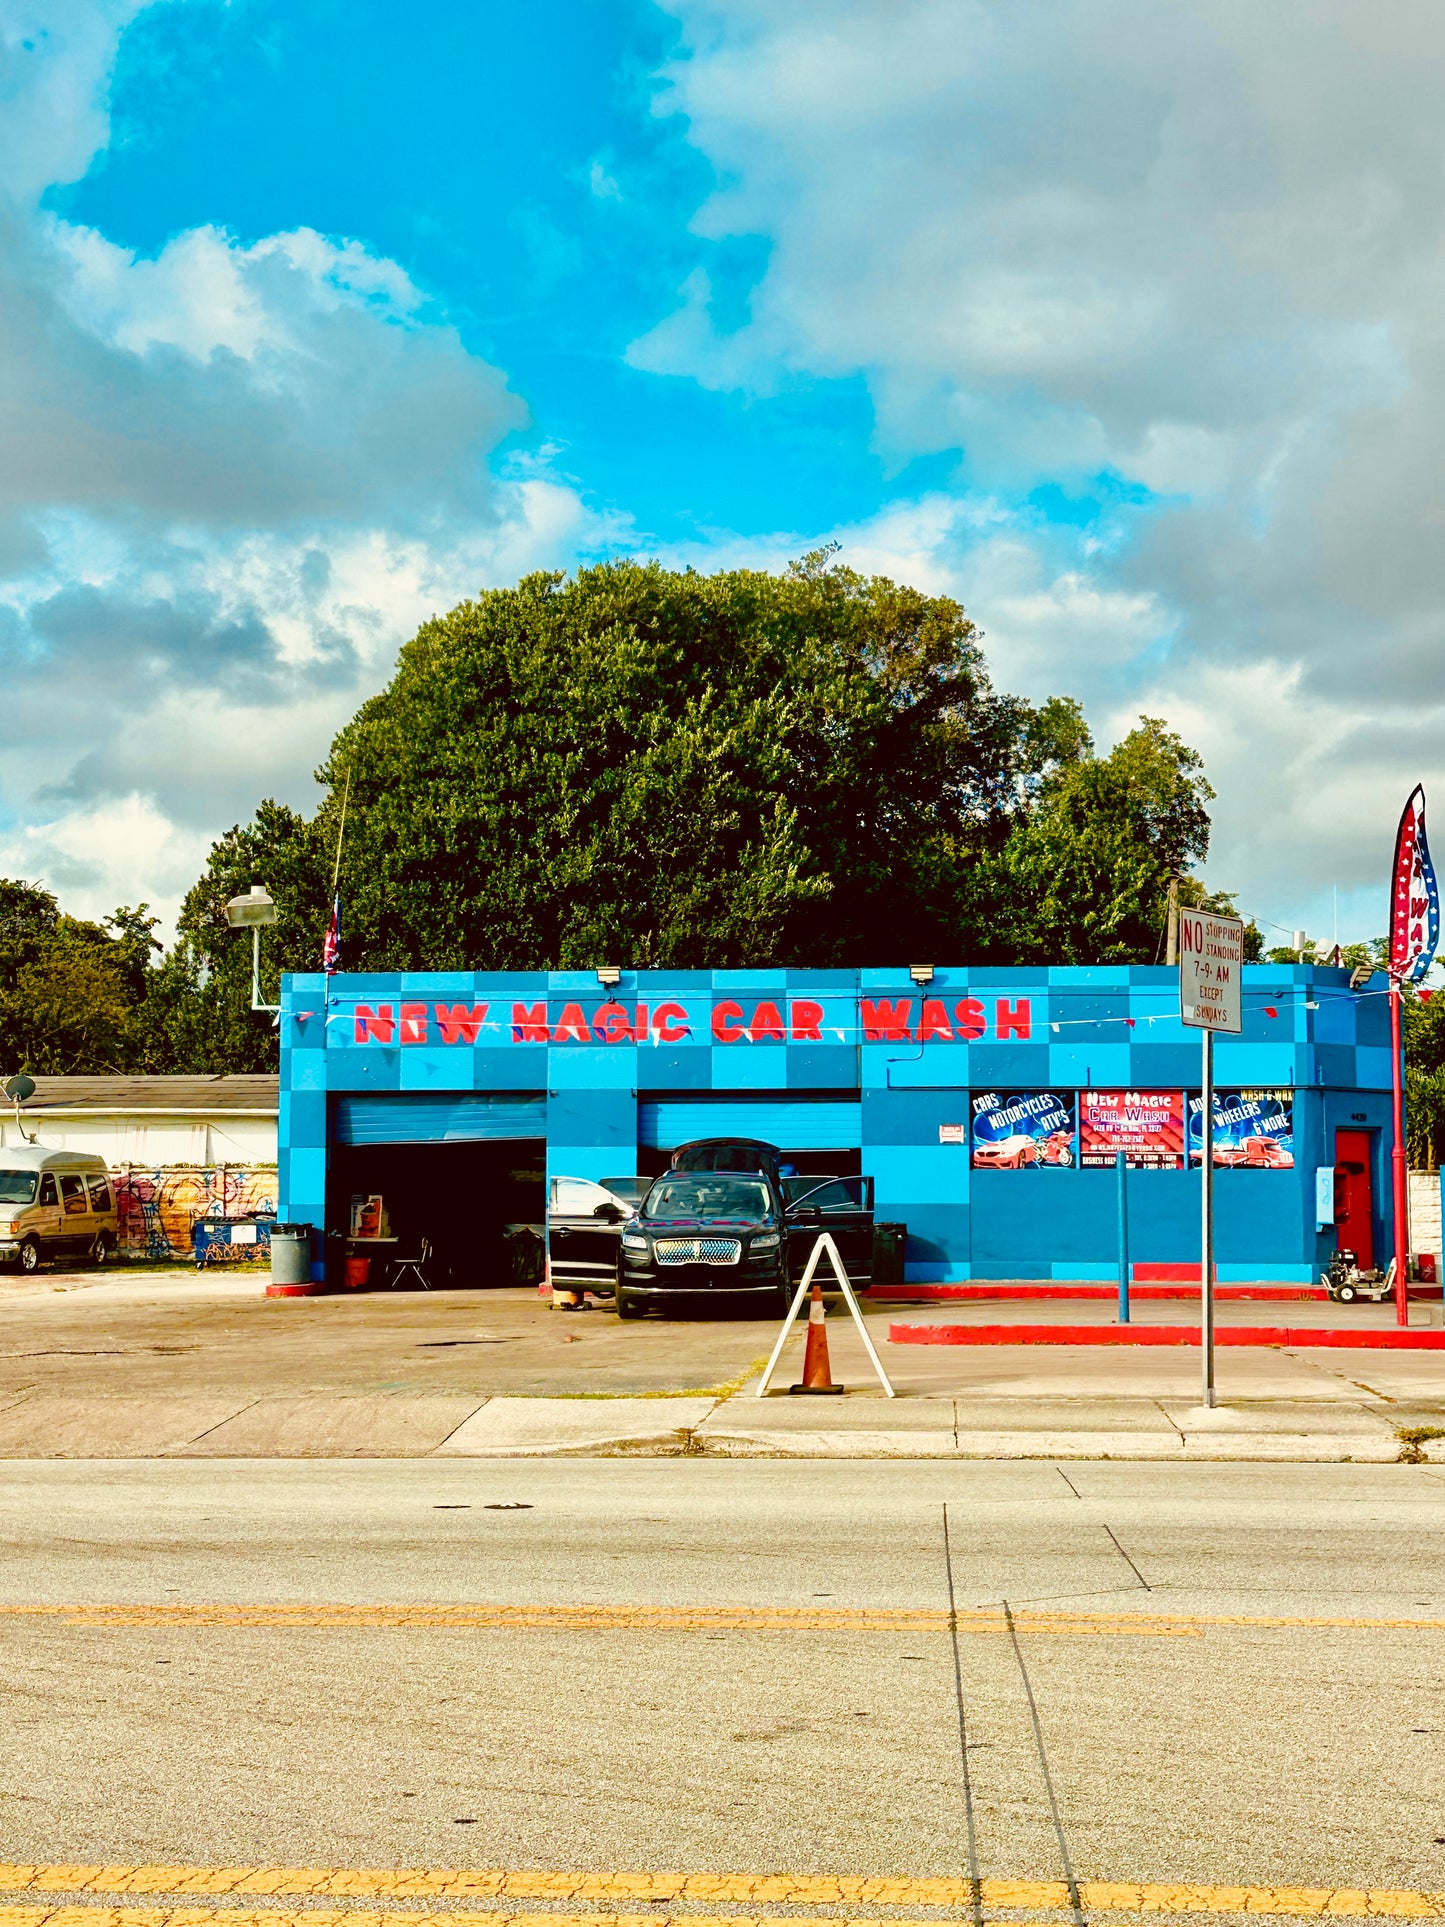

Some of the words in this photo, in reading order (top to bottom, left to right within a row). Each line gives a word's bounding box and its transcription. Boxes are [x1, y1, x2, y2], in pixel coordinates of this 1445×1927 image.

[1184, 918, 1203, 954] NO
[1206, 922, 1240, 943] STOPPING
[1206, 943, 1240, 962] STANDING
[1216, 966, 1230, 983] AM
[1199, 985, 1224, 1002] EXCEPT
[354, 1002, 490, 1044] NEW
[511, 1000, 690, 1044] MAGIC
[711, 999, 825, 1041] CAR
[861, 998, 1032, 1040] WASH
[1196, 1004, 1227, 1022] SUNDAYS
[972, 1093, 999, 1114] CARS
[1086, 1092, 1119, 1107] NEW
[1124, 1091, 1172, 1107] MAGIC
[1189, 1093, 1221, 1114] BOS
[1240, 1089, 1264, 1101] WASH
[1274, 1089, 1293, 1101] WAX
[988, 1093, 1054, 1130] MOTORCYCLES
[1040, 1109, 1070, 1131] ATV'S
[1213, 1101, 1261, 1128] WHEELERS
[1261, 1113, 1290, 1133] MORE
